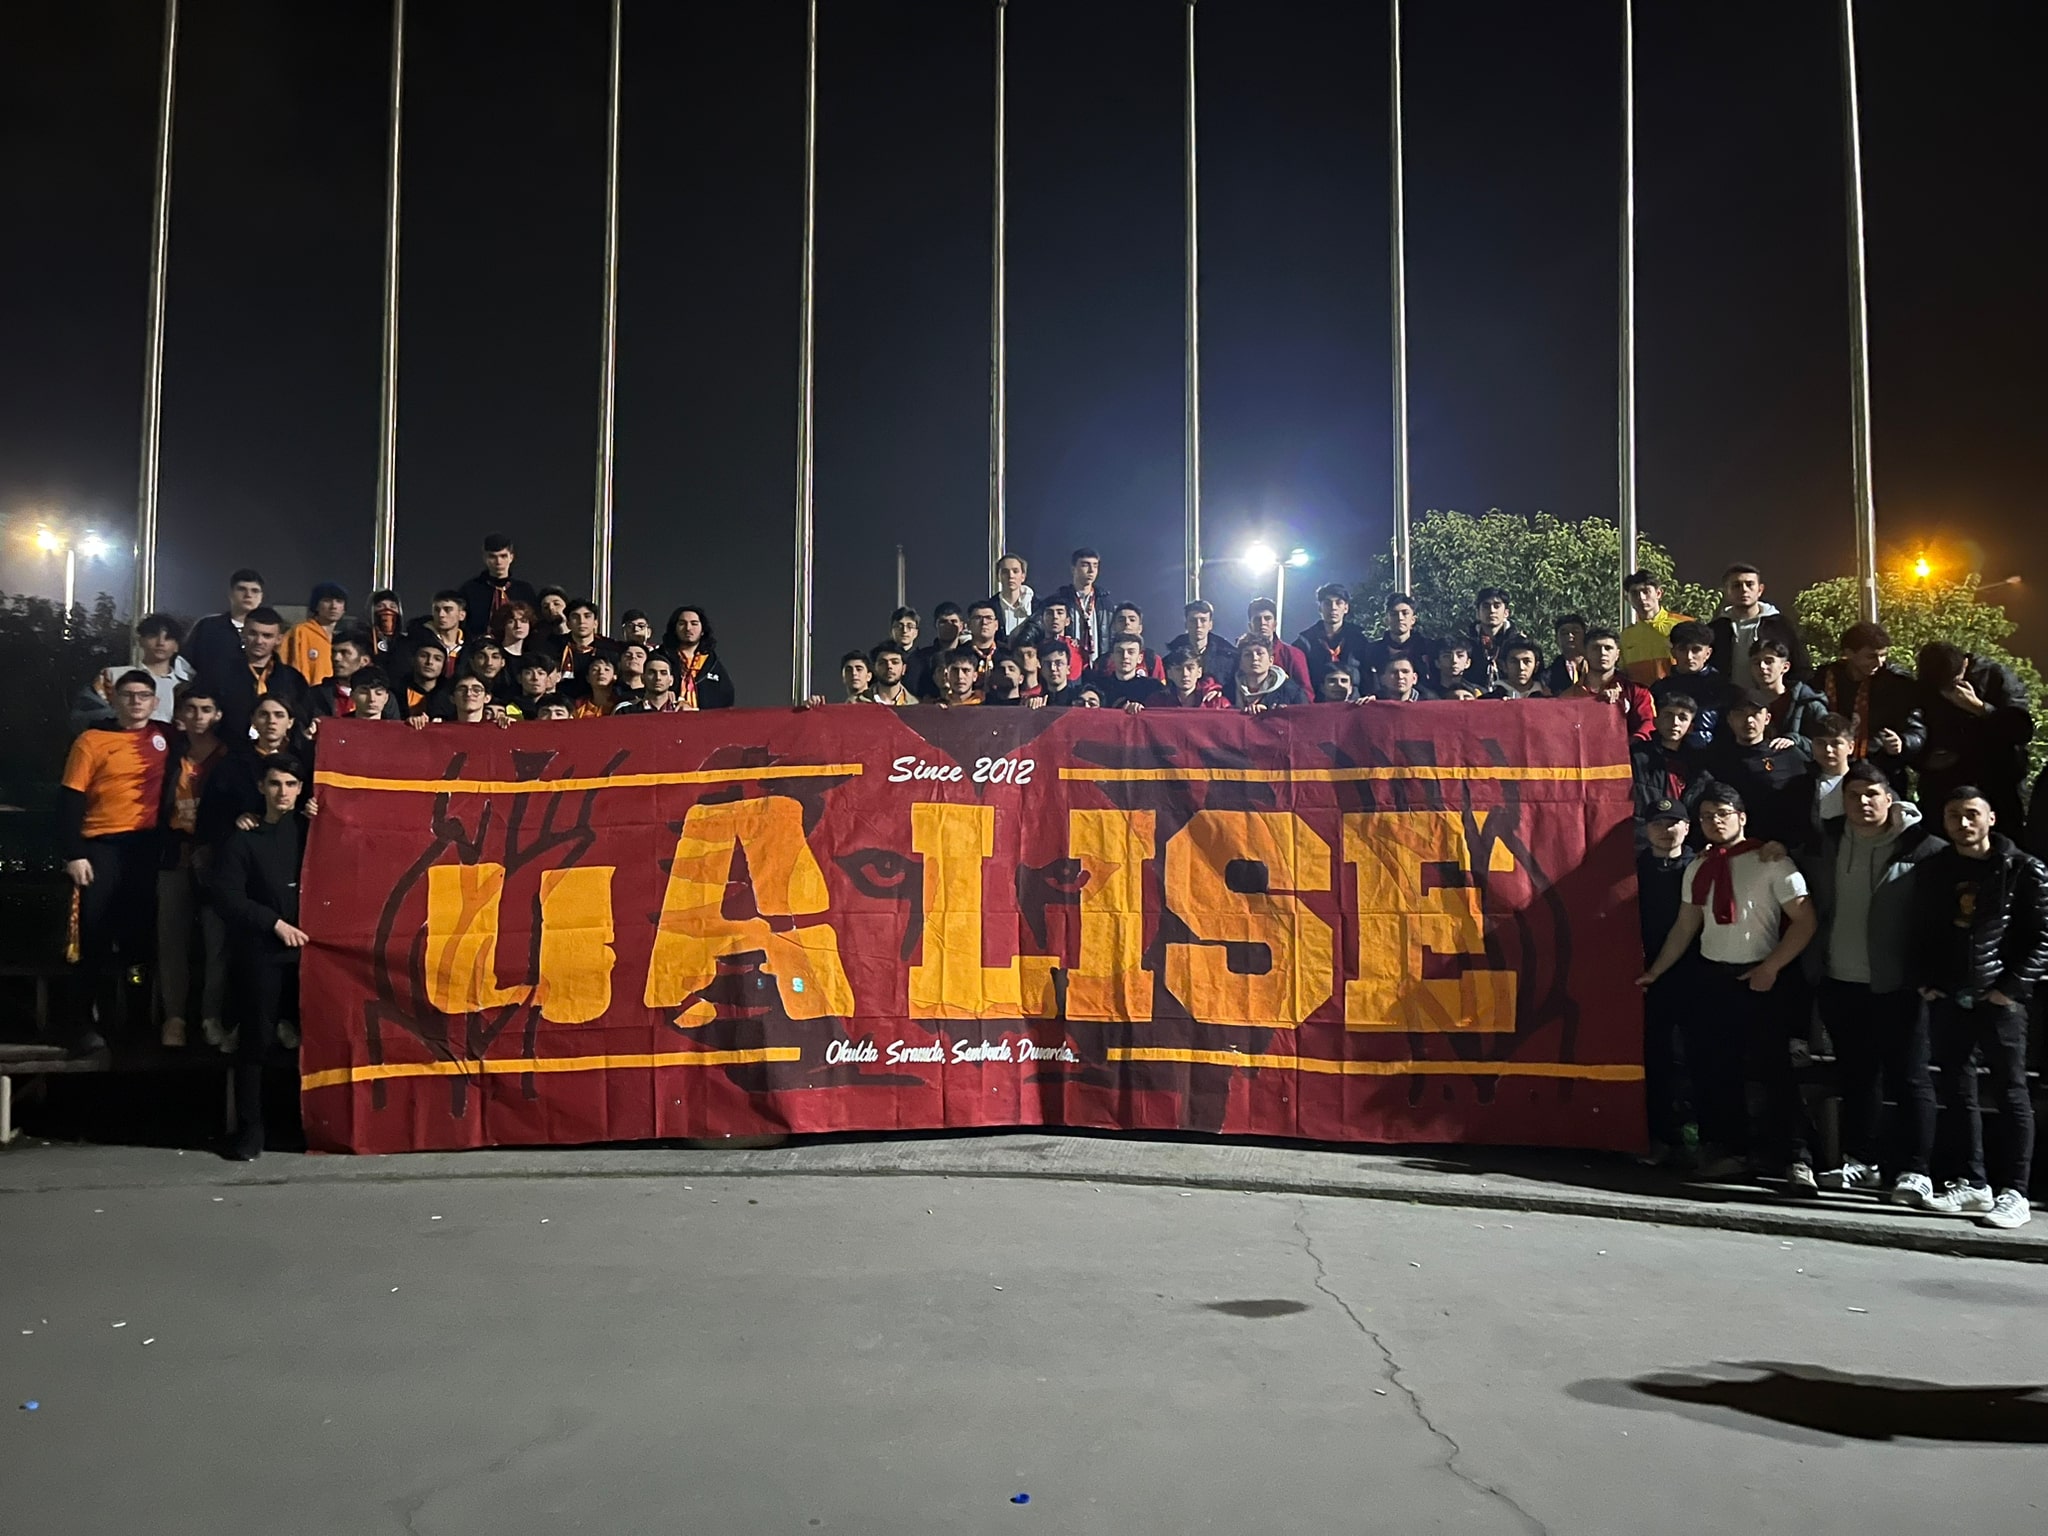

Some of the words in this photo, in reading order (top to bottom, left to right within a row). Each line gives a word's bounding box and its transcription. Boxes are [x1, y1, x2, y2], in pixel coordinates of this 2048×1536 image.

[888, 756, 963, 783] Since
[972, 757, 1035, 785] 2012
[826, 1039, 878, 1065] Okulda
